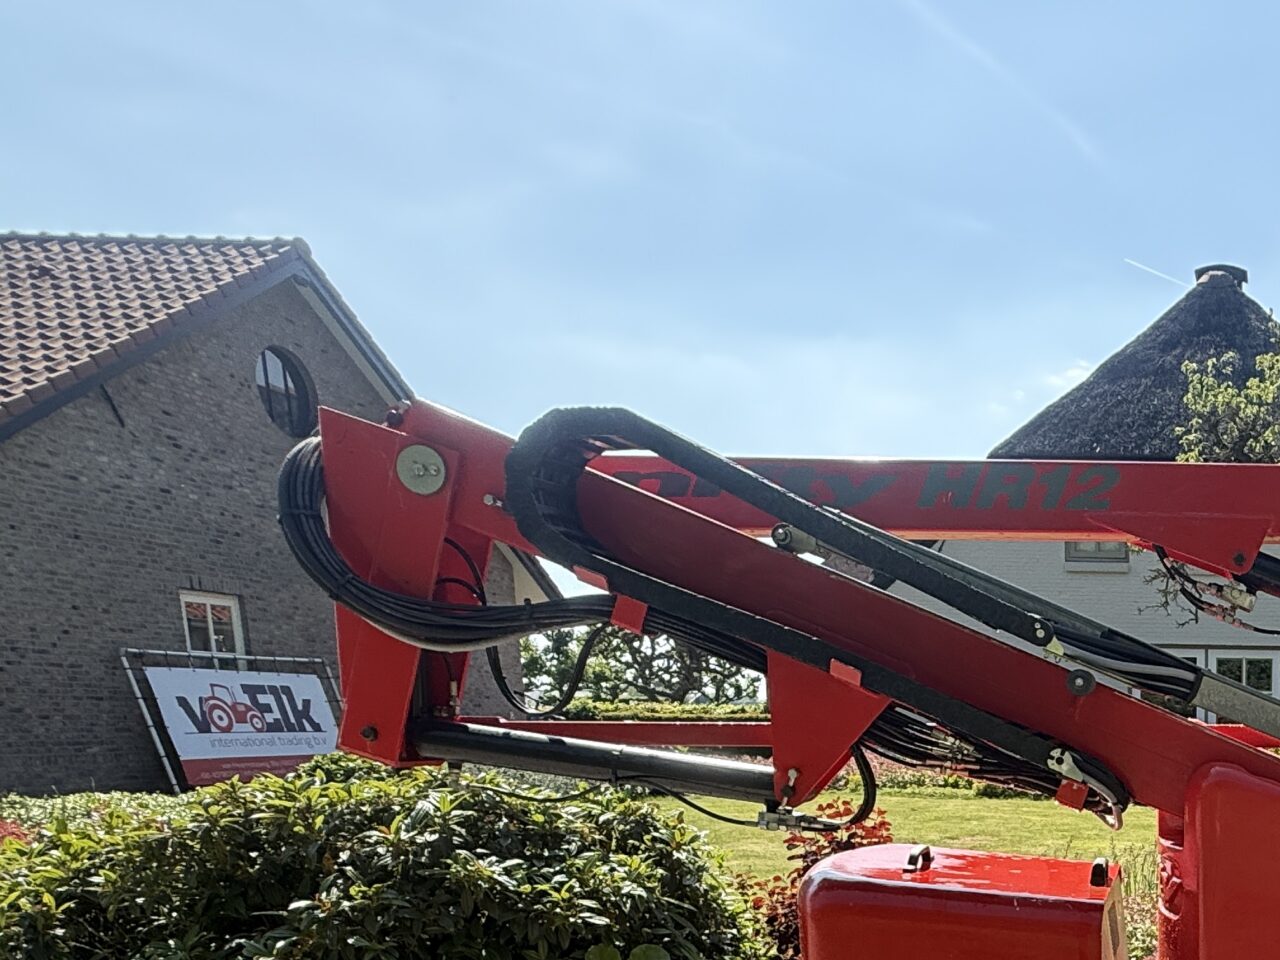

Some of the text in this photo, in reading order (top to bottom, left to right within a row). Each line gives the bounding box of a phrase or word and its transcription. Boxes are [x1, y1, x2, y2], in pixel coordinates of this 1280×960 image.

[917, 464, 1121, 510] HR12
[210, 736, 276, 748] international
[276, 735, 313, 749] trading
